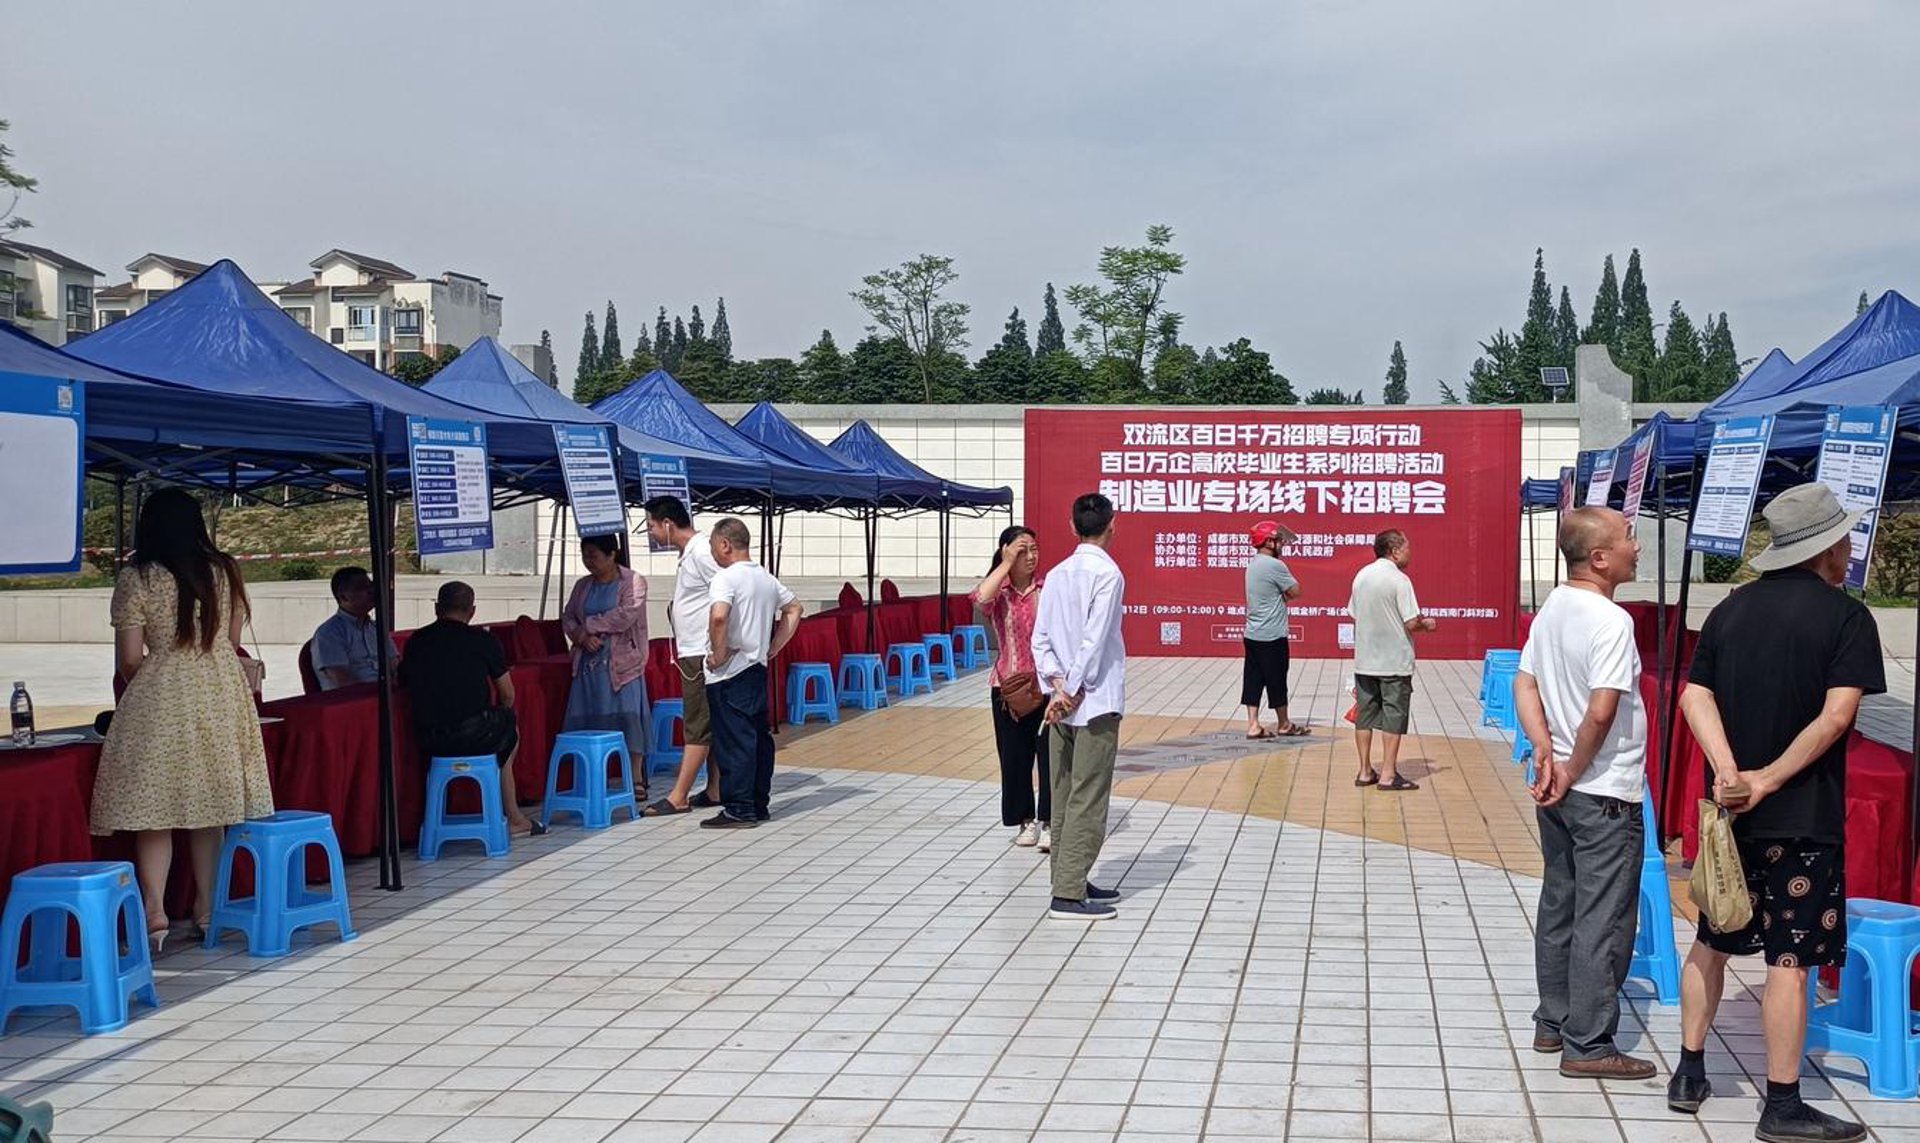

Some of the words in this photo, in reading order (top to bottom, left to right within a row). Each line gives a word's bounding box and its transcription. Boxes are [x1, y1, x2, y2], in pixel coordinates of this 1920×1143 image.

[1122, 423, 1421, 446] 双流区百日千万招聘专项行动
[1100, 452, 1444, 475] 百日万企高校毕业生系列招聘活动
[1098, 479, 1446, 514] 制造业专场线下招聘会
